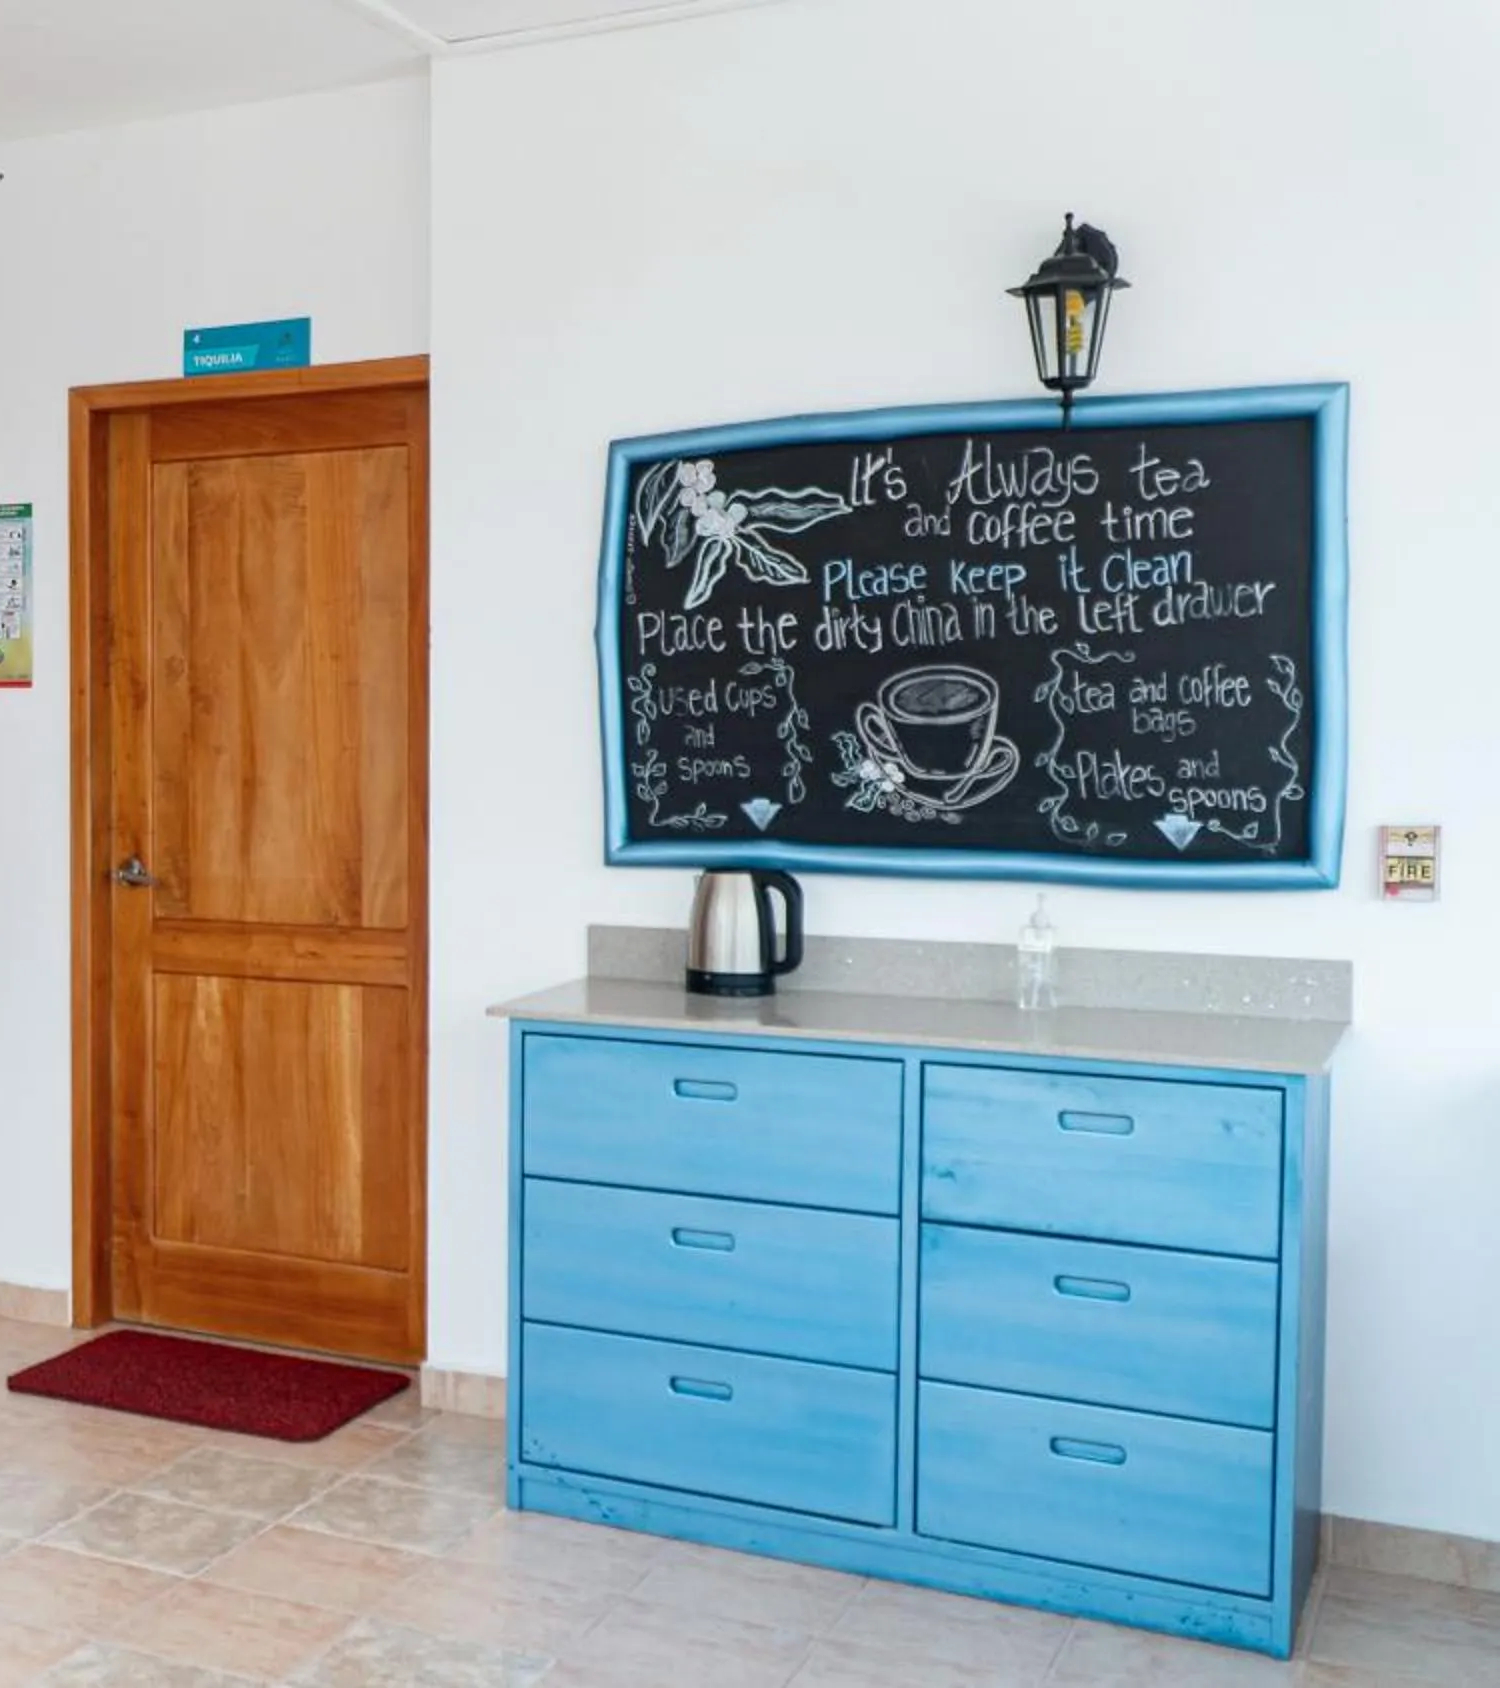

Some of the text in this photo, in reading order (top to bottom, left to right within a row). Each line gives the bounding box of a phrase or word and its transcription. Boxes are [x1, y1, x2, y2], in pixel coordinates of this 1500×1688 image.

[1129, 442, 1211, 500] tea
[905, 503, 950, 536] and
[1100, 502, 1194, 542] time
[823, 558, 928, 602] Please
[1058, 545, 1091, 593] it
[637, 609, 727, 656] Place
[737, 606, 799, 654] the
[814, 603, 882, 653] dirty
[970, 596, 996, 640] in
[1005, 592, 1059, 636] the
[1078, 592, 1144, 634] left
[1152, 579, 1276, 627] drawer
[1073, 670, 1116, 713] tea
[1129, 671, 1167, 704] and
[683, 722, 716, 748] and
[1132, 707, 1197, 743] bags
[1177, 749, 1220, 780] and
[1168, 785, 1267, 819] spoons
